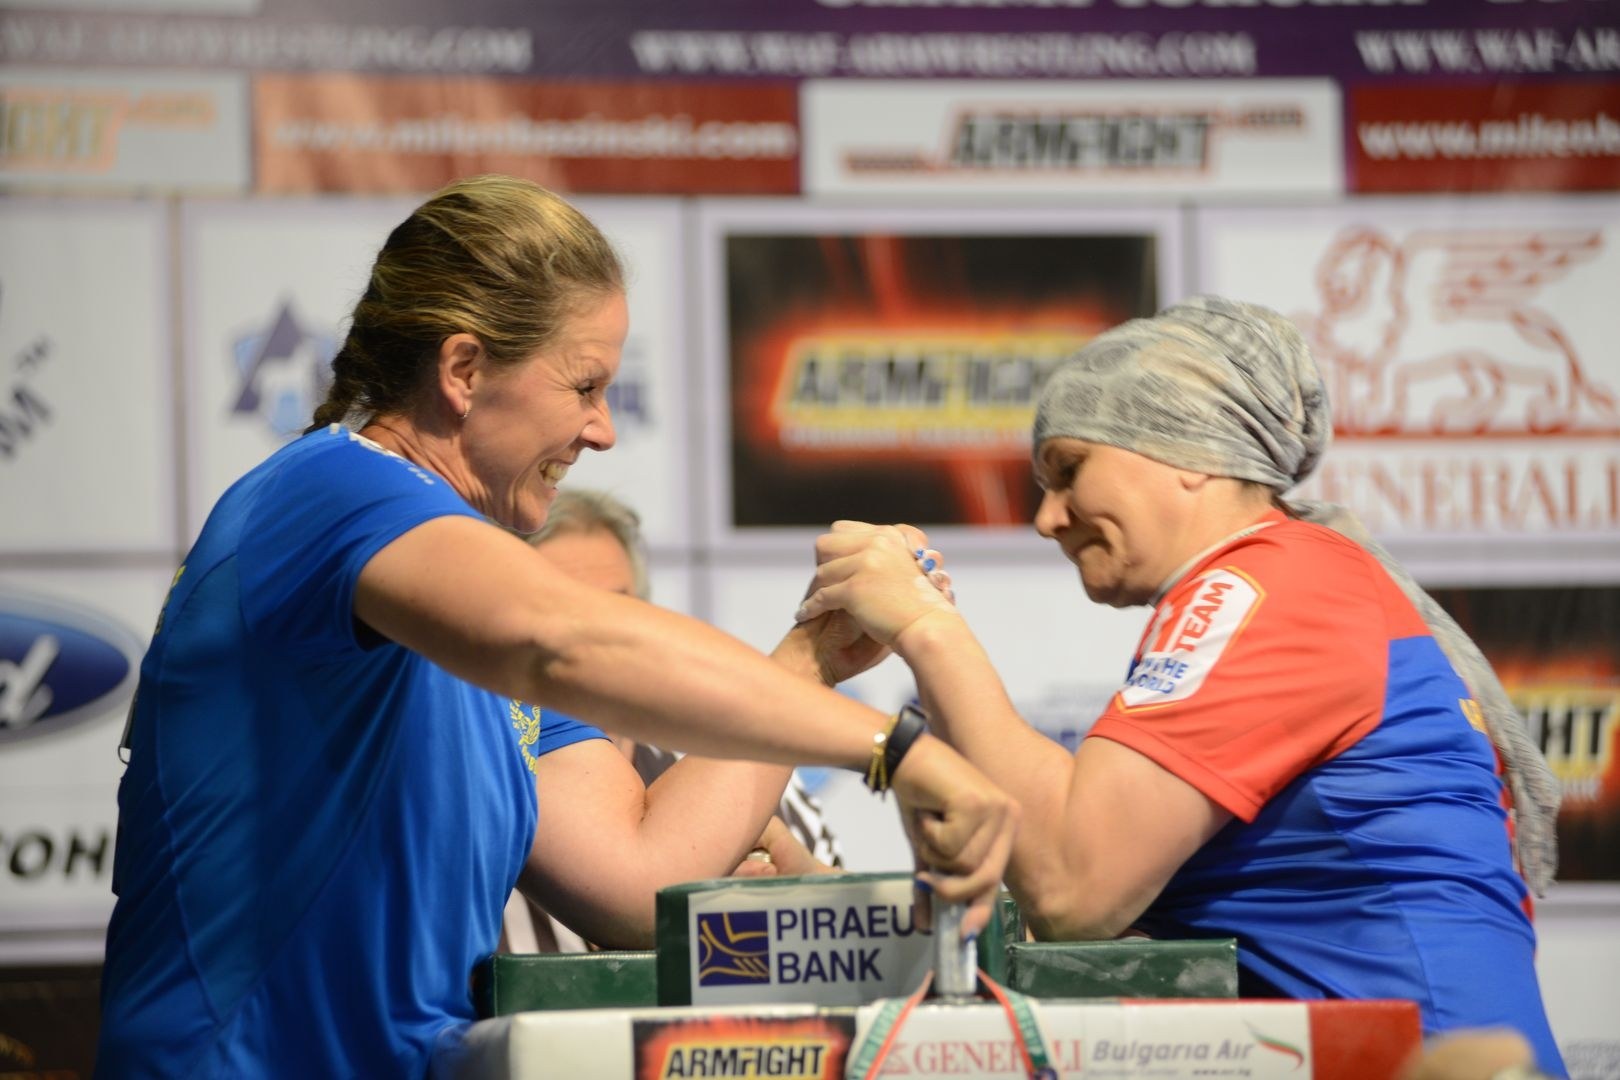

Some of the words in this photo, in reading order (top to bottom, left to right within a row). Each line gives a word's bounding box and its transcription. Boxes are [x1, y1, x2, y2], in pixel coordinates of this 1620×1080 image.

[1298, 460, 1620, 528] ENERALI
[1173, 581, 1235, 652] TEAM
[776, 905, 933, 941] PIRAEU
[777, 948, 883, 984] BANK
[667, 1046, 824, 1078] ARMFIGHT
[913, 1039, 1082, 1074] GENELI
[1093, 1040, 1210, 1066] Bulgaria
[1216, 1039, 1253, 1060] Air
